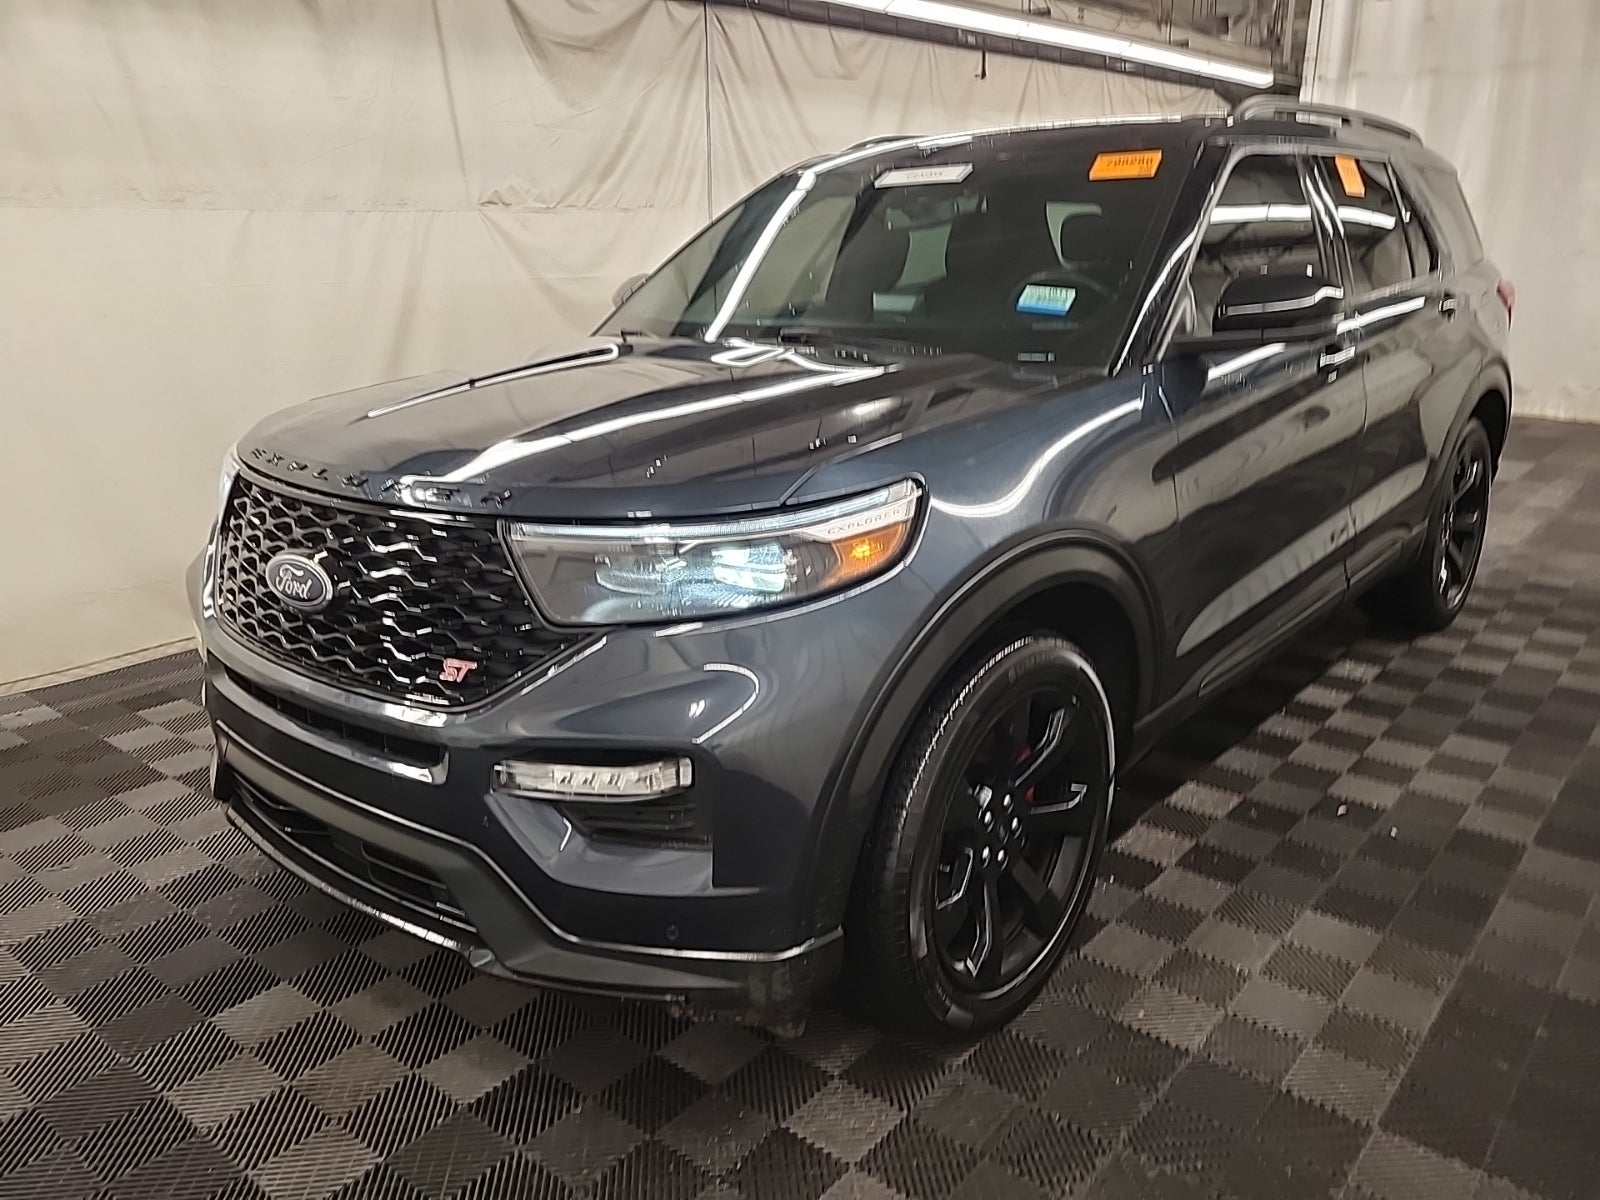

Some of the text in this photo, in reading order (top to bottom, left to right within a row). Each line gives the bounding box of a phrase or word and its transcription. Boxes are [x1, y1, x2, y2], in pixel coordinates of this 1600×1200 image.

[827, 509, 901, 535] EXPLORER
[275, 564, 313, 600] Ford
[439, 657, 478, 683] ST
